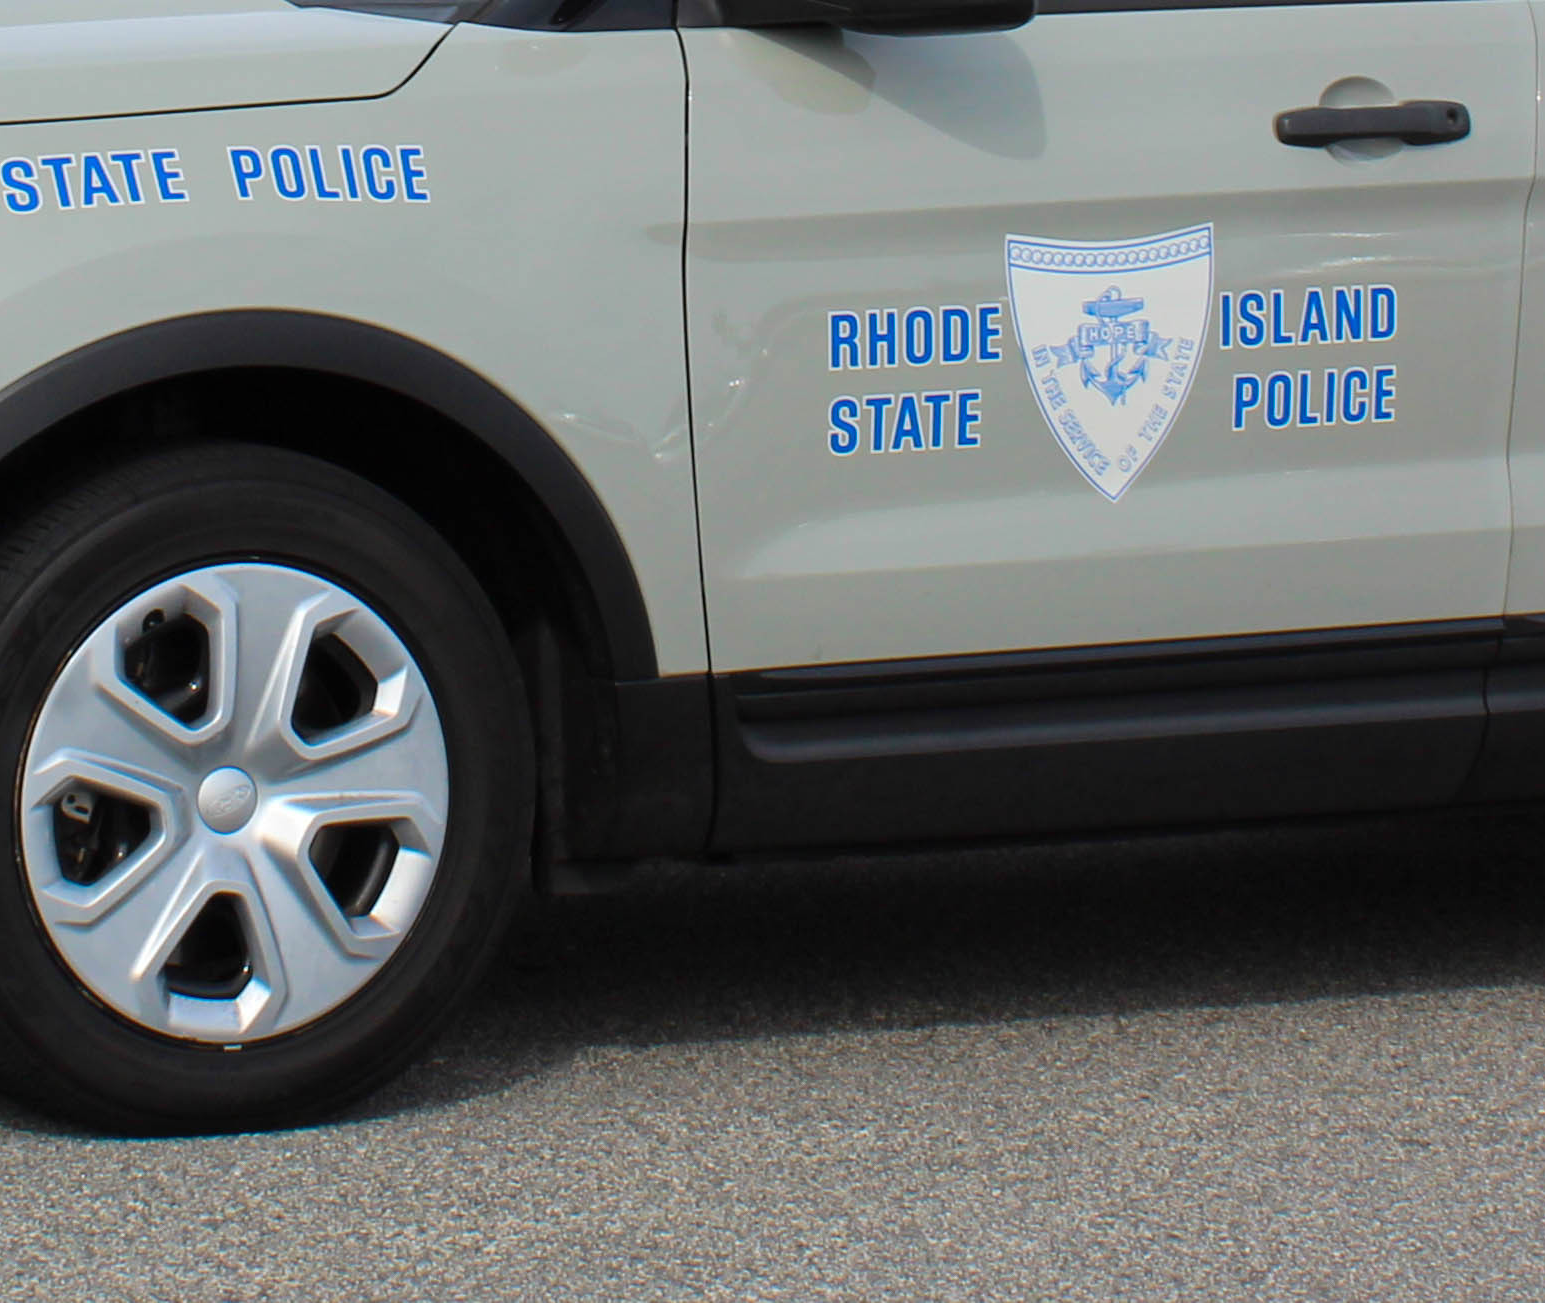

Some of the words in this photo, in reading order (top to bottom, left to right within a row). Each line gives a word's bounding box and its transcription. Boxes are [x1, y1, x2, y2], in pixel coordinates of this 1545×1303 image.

[0, 149, 190, 214] STATE
[227, 144, 430, 203] POLICE
[828, 303, 1003, 371] RHODE
[1088, 324, 1136, 342] HOPE
[1219, 284, 1397, 349] ISLAND
[828, 389, 982, 456] STATE
[1231, 365, 1396, 431] POLICE
